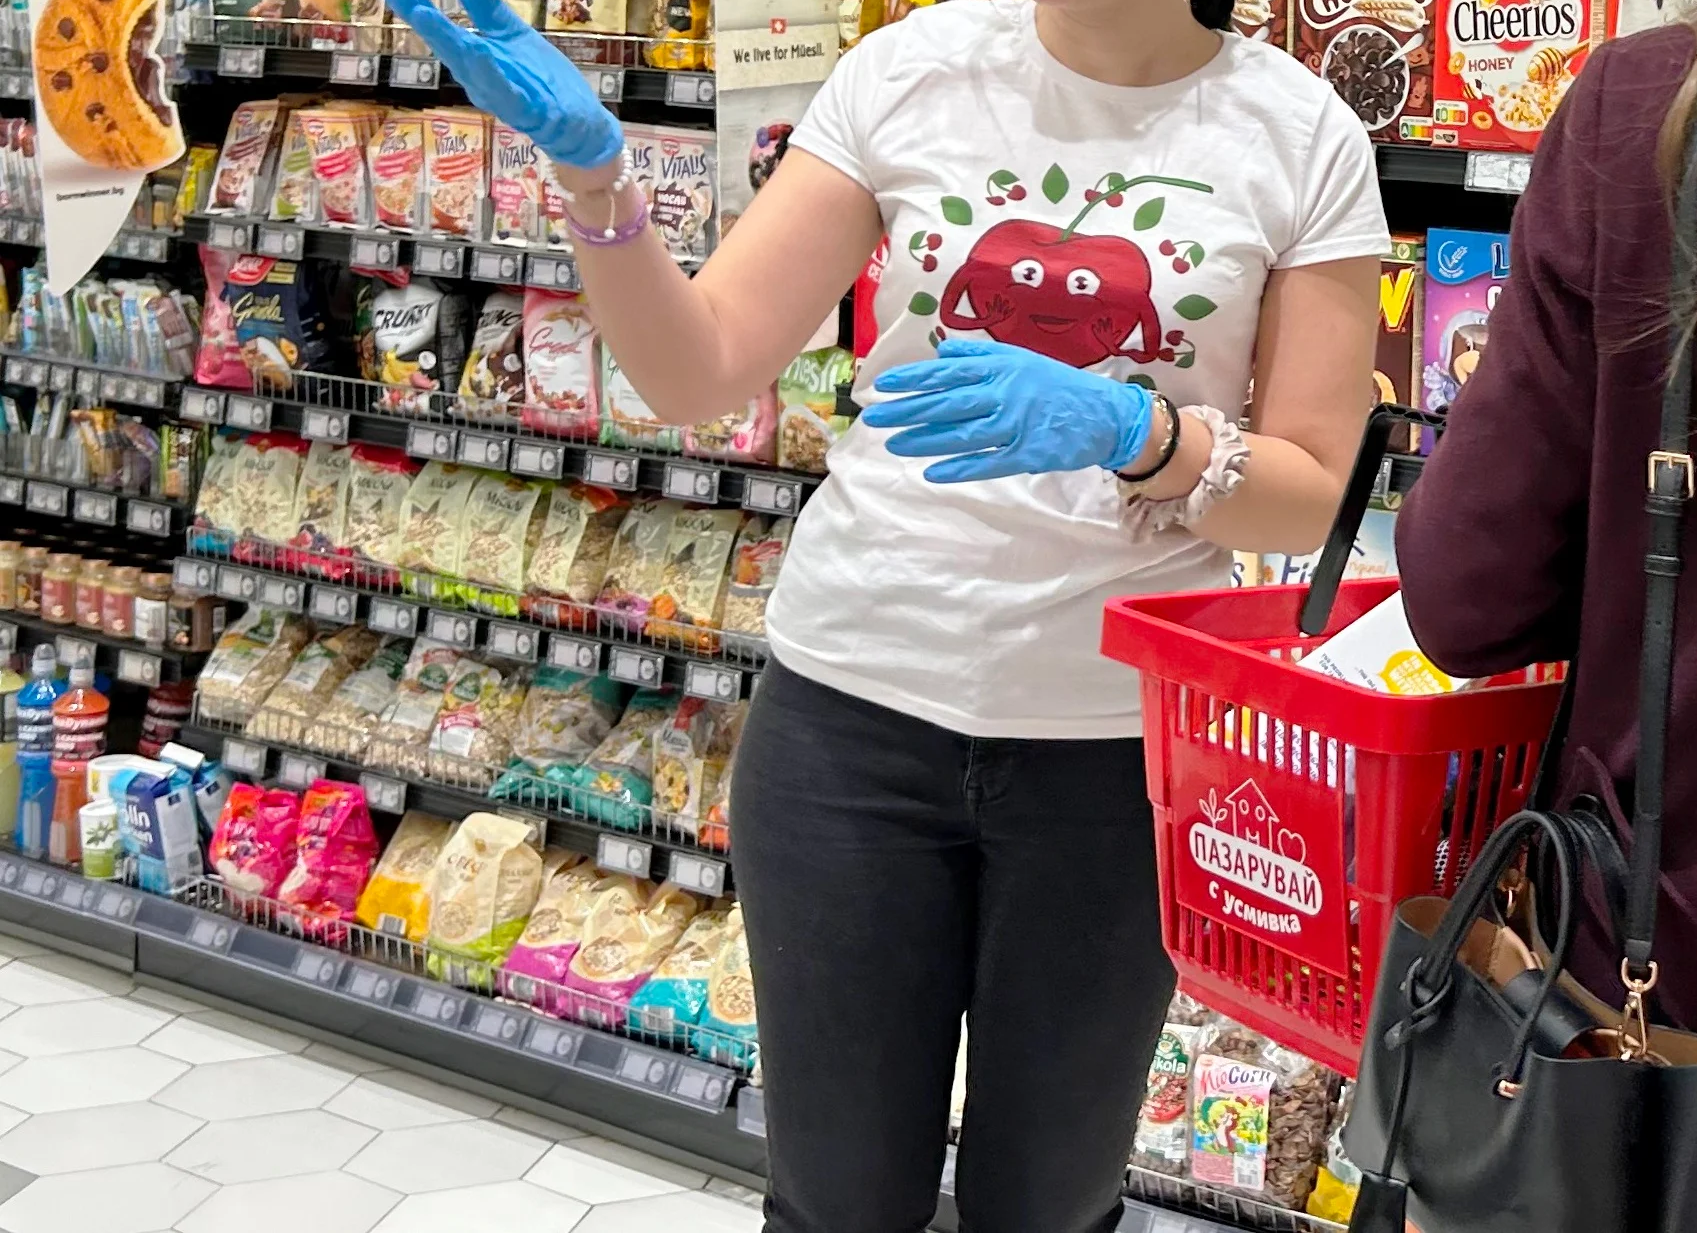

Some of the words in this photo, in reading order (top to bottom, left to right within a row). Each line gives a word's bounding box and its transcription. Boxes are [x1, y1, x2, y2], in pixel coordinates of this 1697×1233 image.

[734, 49, 751, 63] We
[754, 47, 771, 62] live
[774, 45, 787, 60] for
[1468, 55, 1515, 73] HONEY
[500, 145, 538, 169] VITALIS
[661, 154, 707, 180] VITALIS
[1194, 833, 1319, 910] ПАЗАРУВАЙ
[1208, 881, 1219, 900] с
[1222, 892, 1302, 934] усмивка
